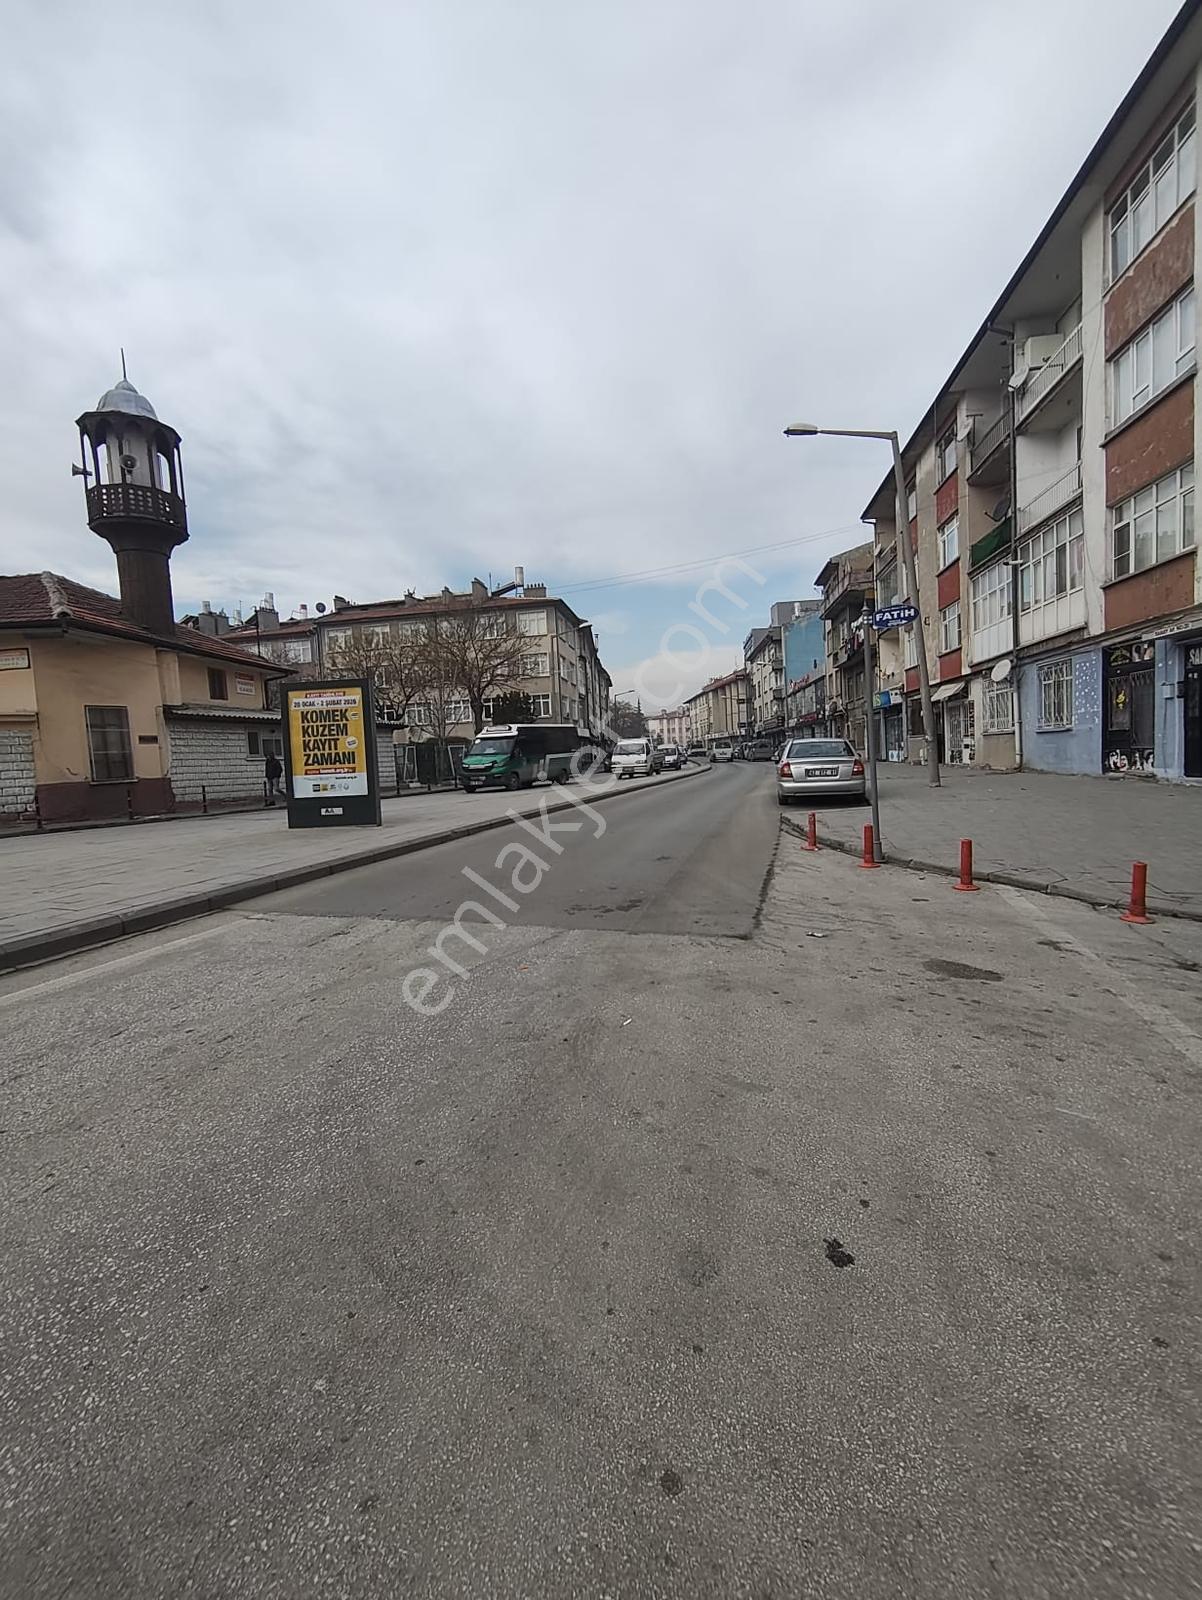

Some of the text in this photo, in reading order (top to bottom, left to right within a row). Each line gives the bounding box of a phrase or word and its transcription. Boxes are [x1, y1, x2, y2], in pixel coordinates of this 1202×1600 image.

[300, 709, 350, 724] KOMEK
[301, 723, 349, 738] KUZEM
[302, 738, 340, 752] KAYIT
[303, 751, 356, 767] ZAMANI
